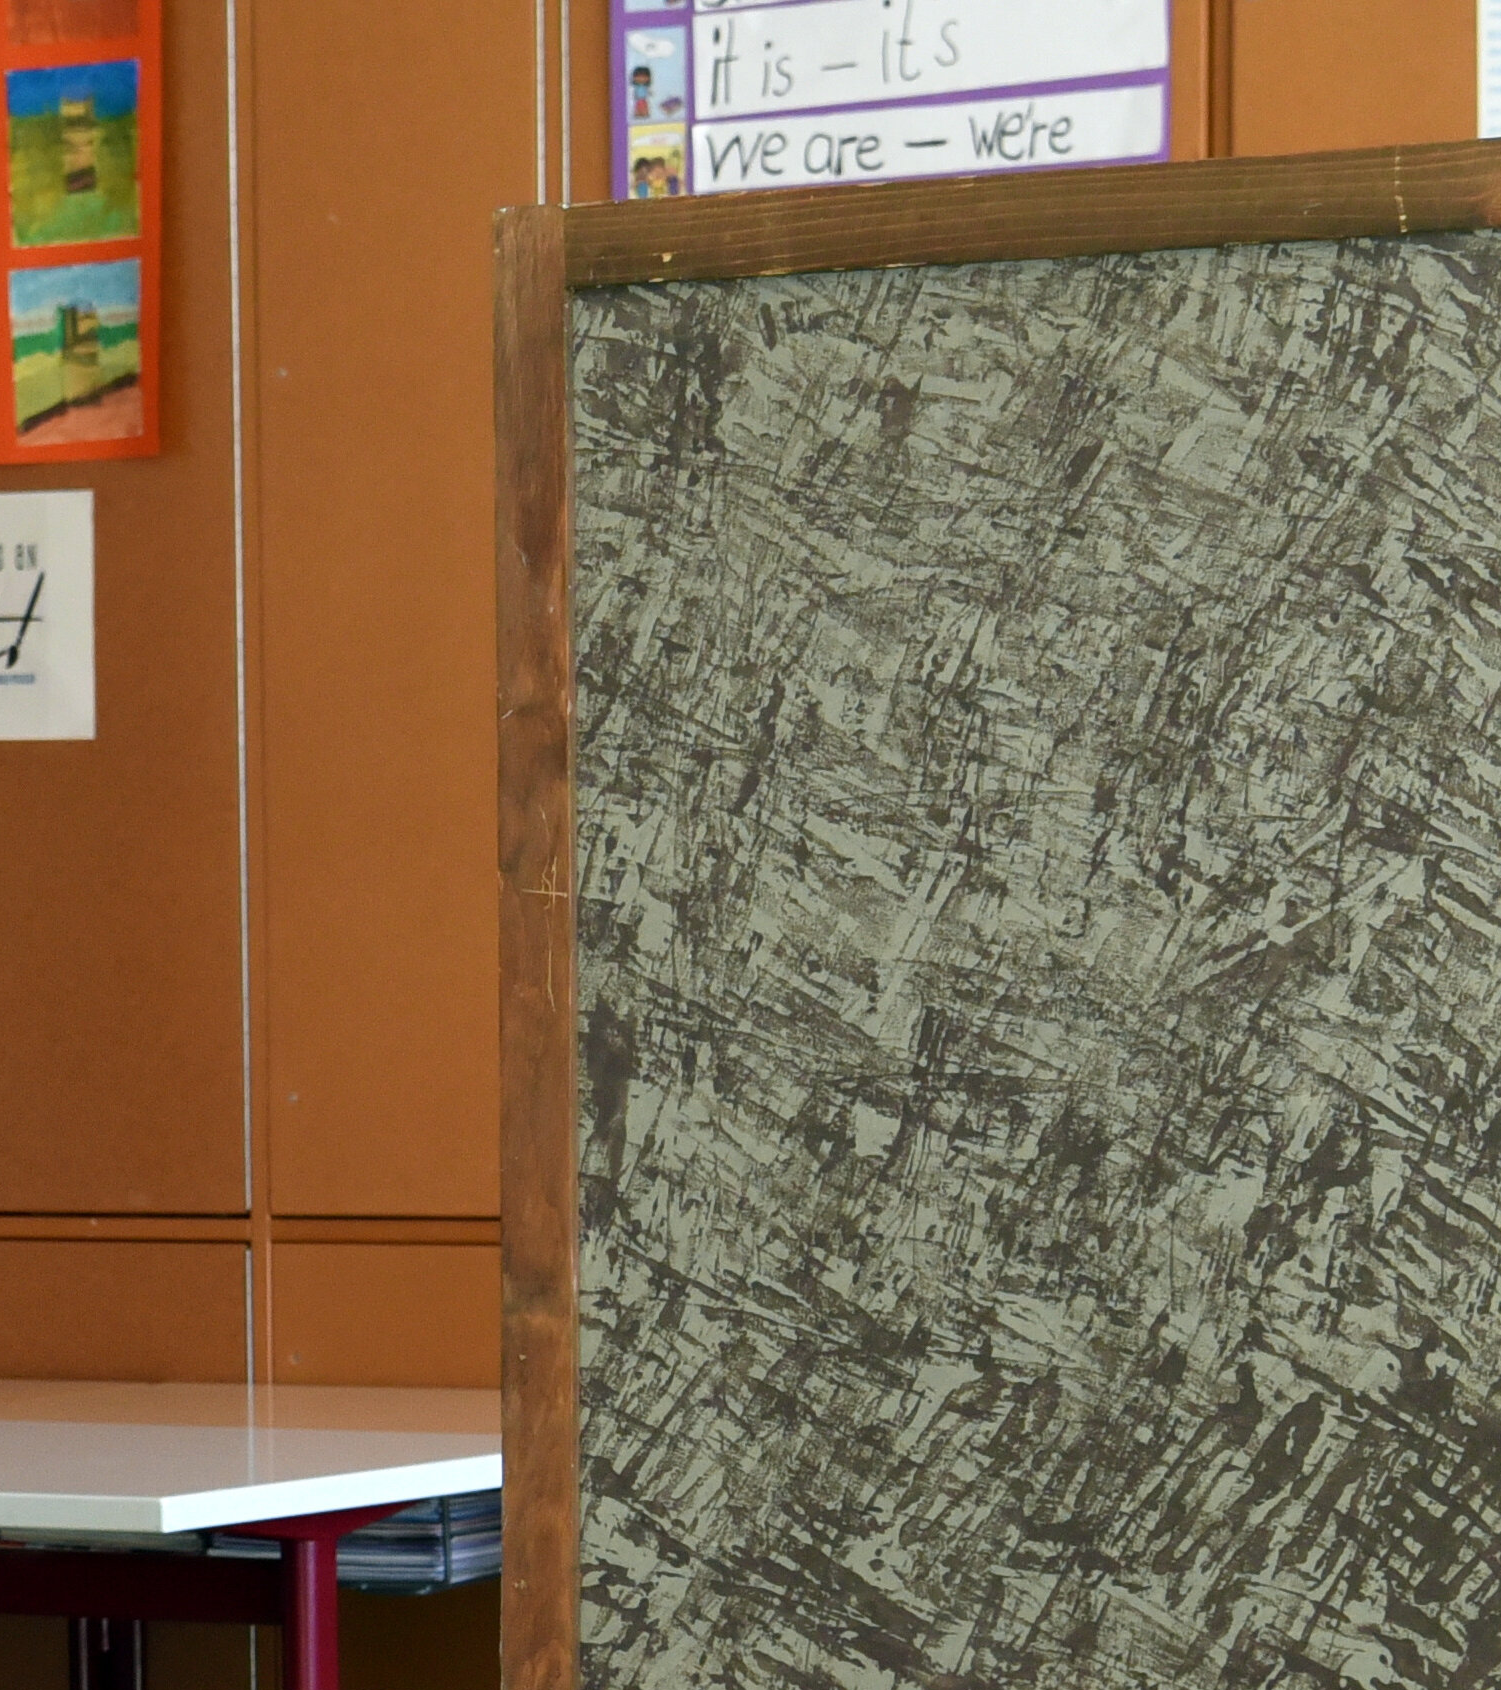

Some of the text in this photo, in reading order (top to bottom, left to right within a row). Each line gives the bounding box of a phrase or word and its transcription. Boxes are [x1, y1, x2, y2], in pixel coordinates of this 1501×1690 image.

[710, 17, 738, 106] it
[761, 40, 794, 98] is
[804, 130, 884, 177] are
